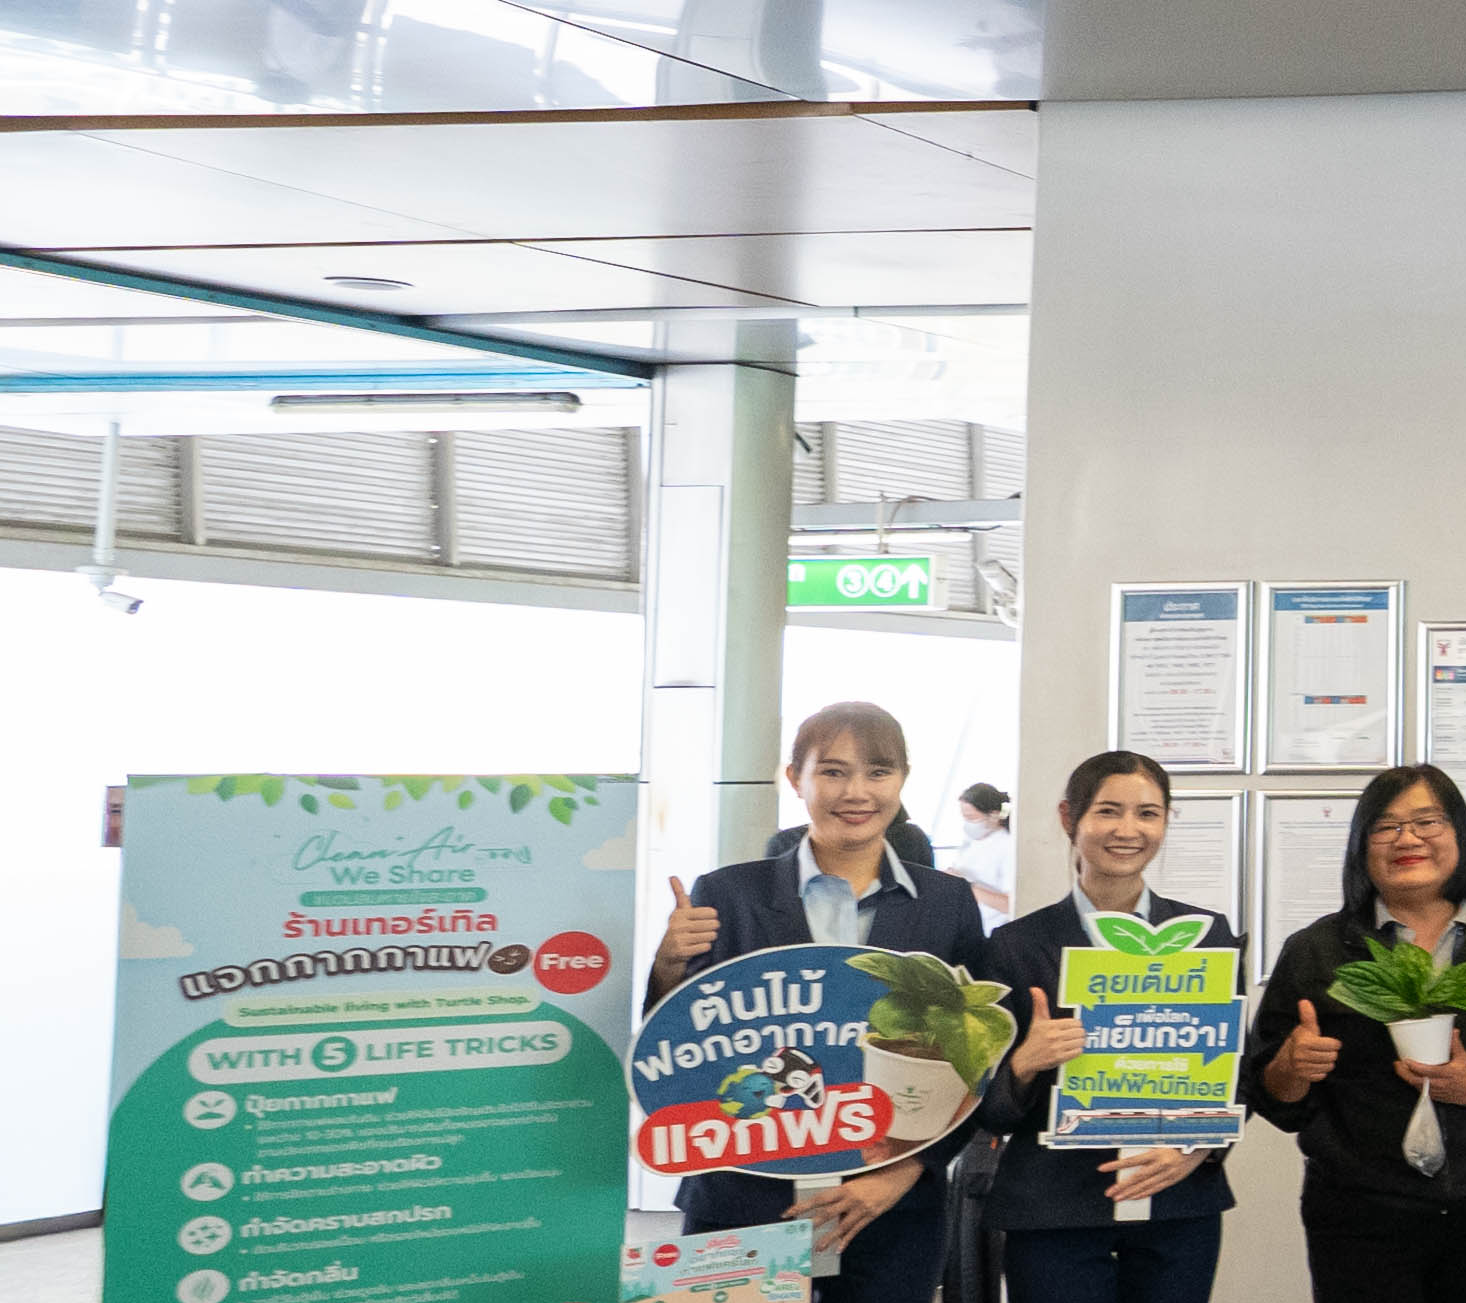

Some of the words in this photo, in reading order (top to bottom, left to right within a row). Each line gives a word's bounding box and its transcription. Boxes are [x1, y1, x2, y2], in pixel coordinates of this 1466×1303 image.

[330, 866, 380, 886] We
[388, 864, 476, 885] Share
[283, 908, 499, 939] ร้านเทอร์เทิล
[540, 952, 604, 971] Free
[1087, 958, 1208, 1004] ลุยเต็มที่
[689, 969, 827, 1032] ต้นไม้
[206, 1047, 301, 1073] WITH
[322, 1040, 348, 1067] 5
[365, 1039, 436, 1062] LIFE
[444, 1032, 559, 1058] TRICKS
[633, 1021, 870, 1083] ฟอกอากาศ
[1067, 1070, 1228, 1097] รถไฟฟ้าบีทีเอส
[652, 1084, 878, 1166] แจกฟรี
